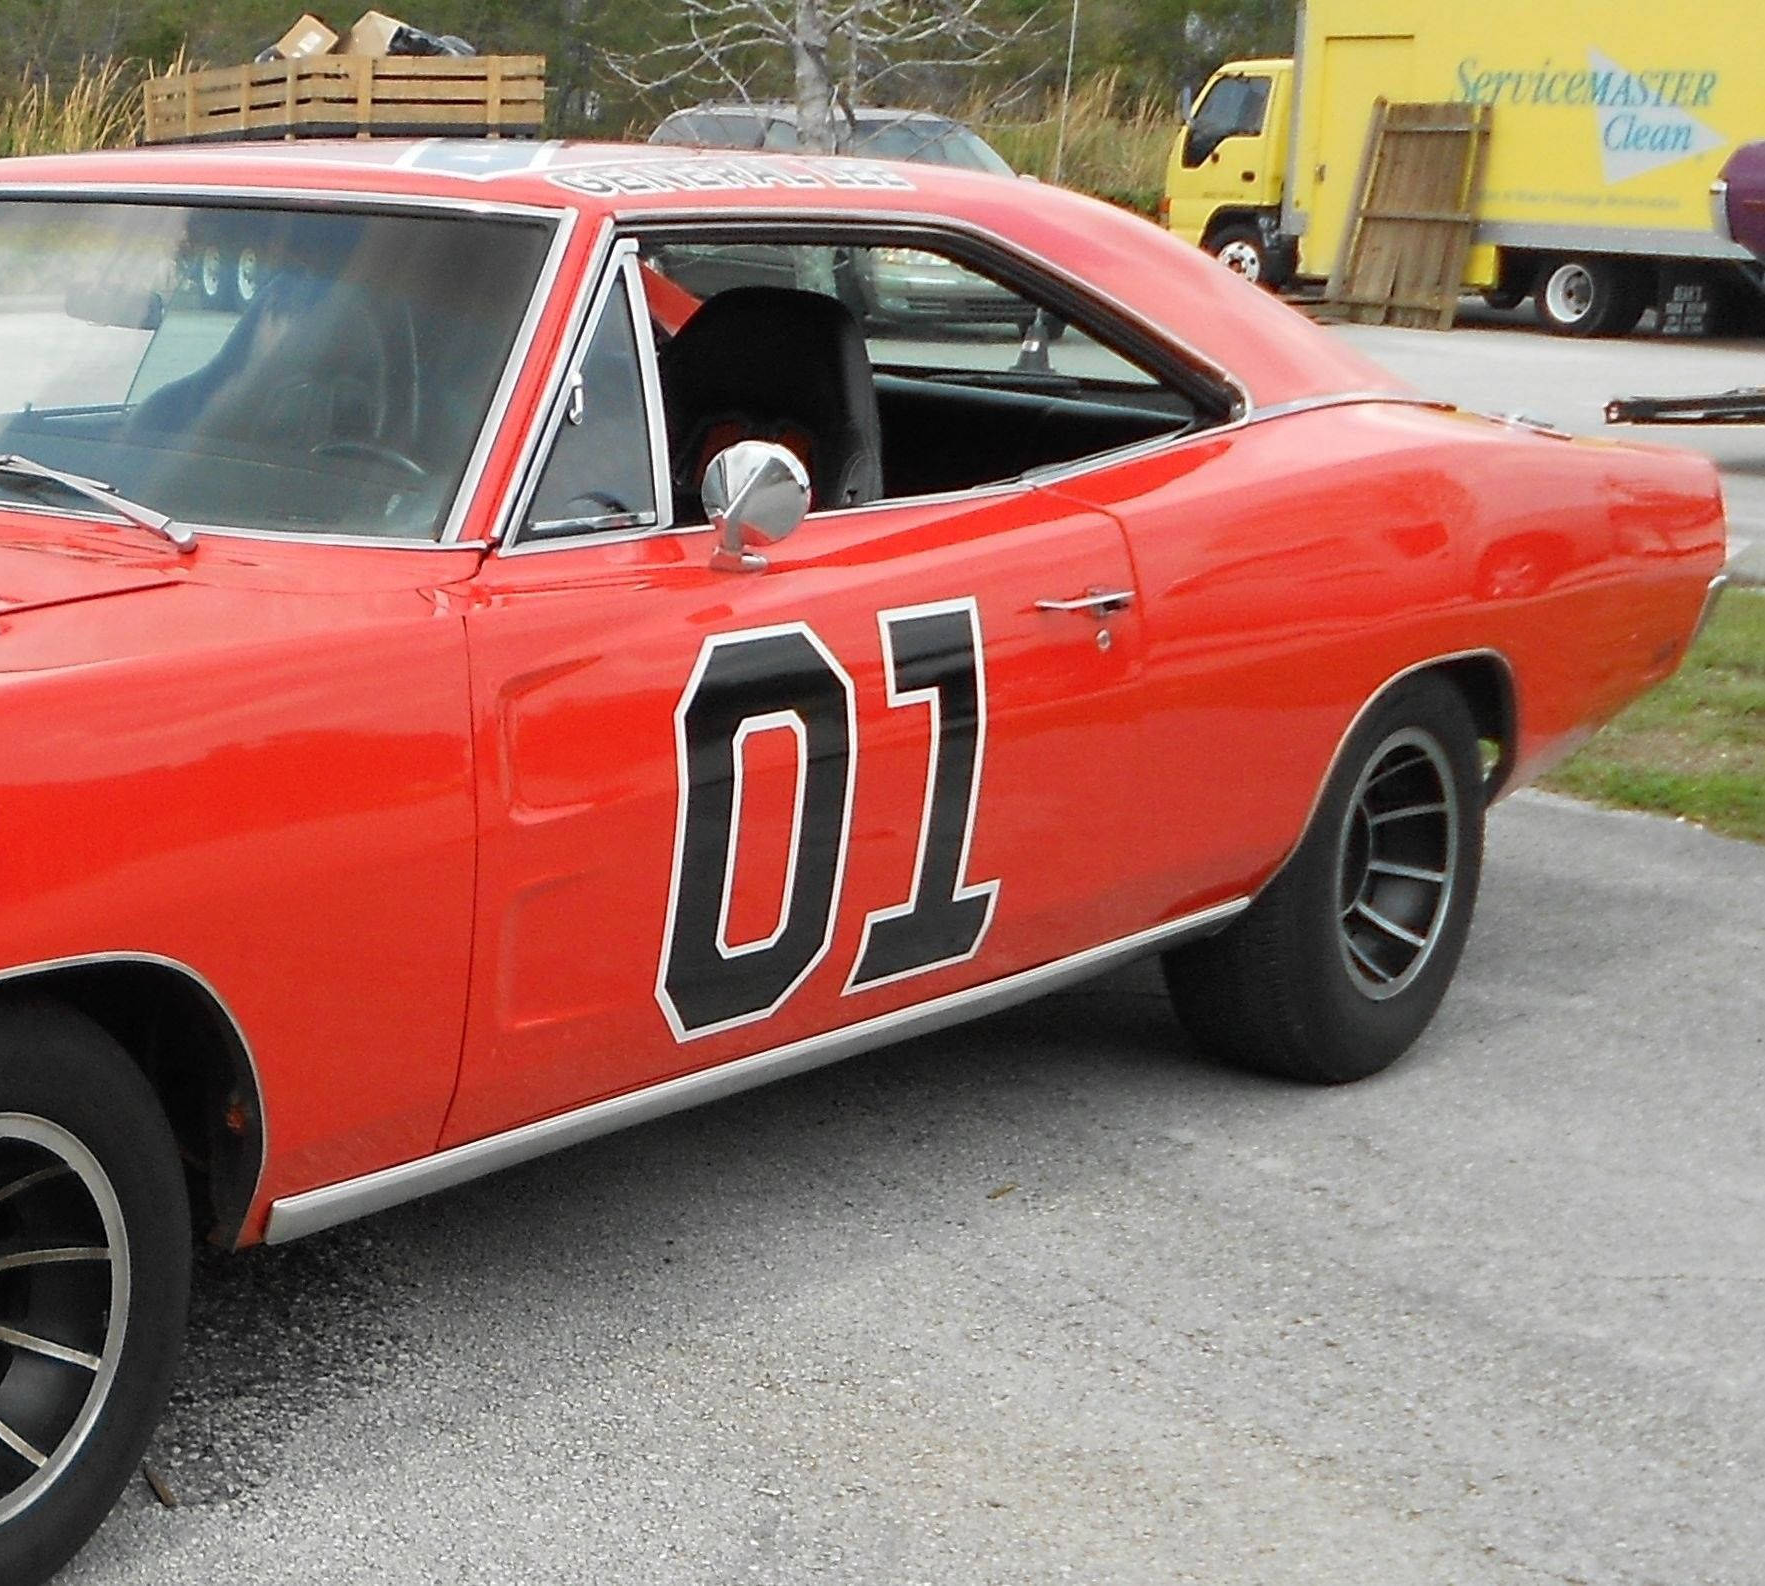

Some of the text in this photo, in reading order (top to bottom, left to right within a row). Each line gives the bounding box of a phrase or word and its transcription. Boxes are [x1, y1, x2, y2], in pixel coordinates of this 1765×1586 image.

[1603, 114, 1692, 151] Clean
[544, 158, 916, 197] GENERAL LEE
[654, 595, 1001, 1044] 01
